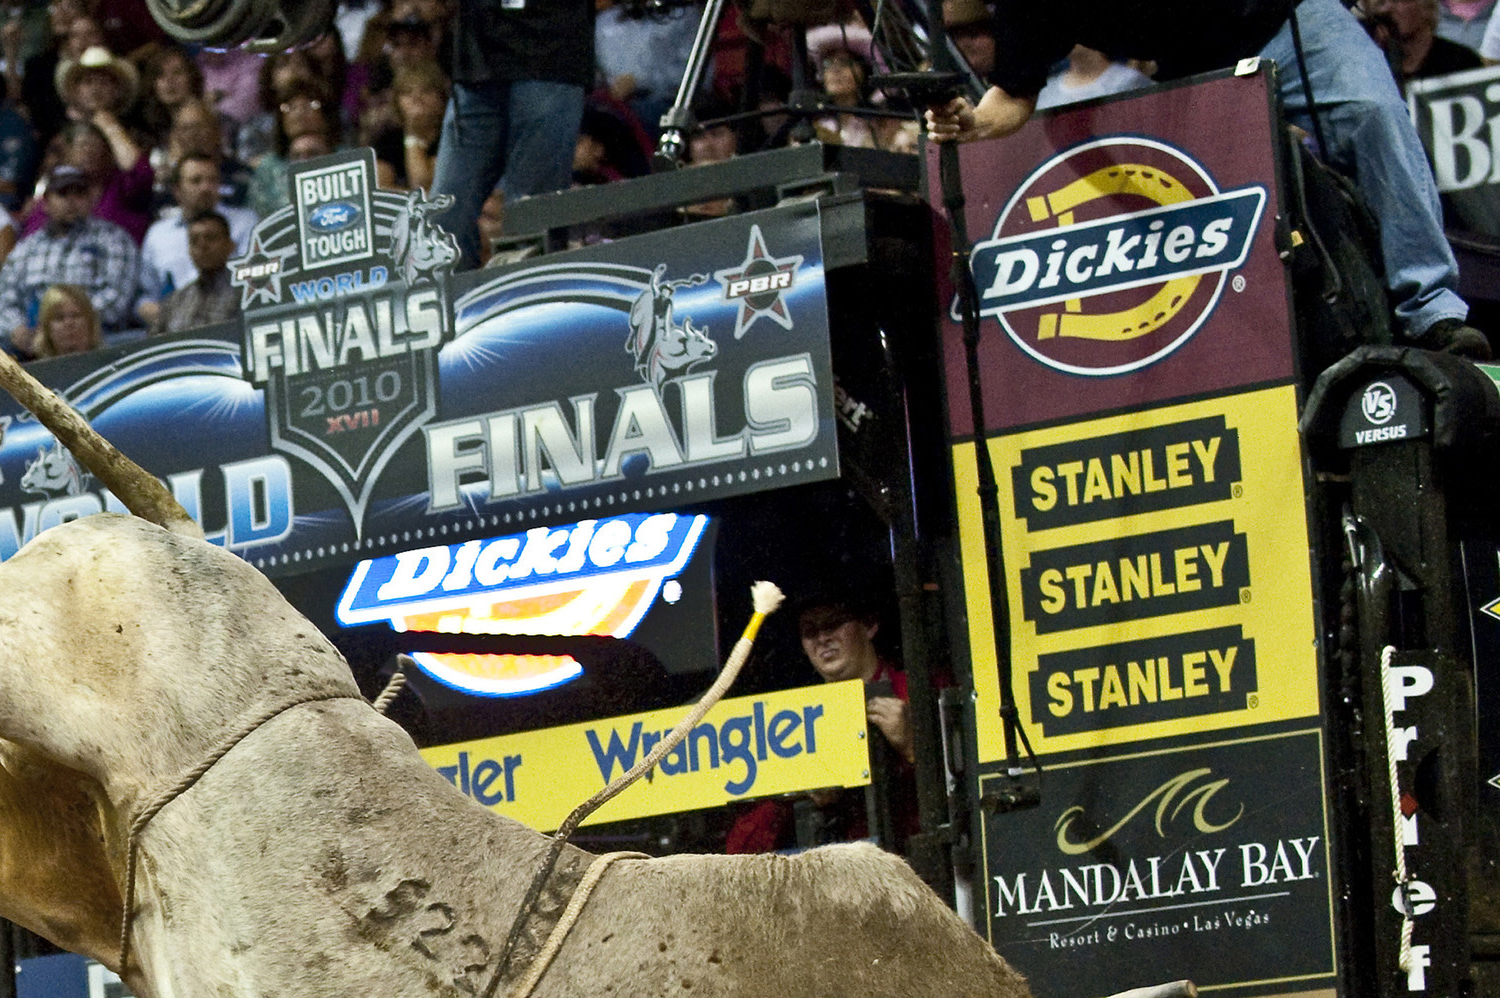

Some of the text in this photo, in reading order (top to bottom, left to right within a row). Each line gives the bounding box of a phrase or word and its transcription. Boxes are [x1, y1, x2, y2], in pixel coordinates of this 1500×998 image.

[303, 168, 362, 205] BUILT
[307, 229, 366, 259] TOUGH
[982, 210, 1233, 299] Dickies
[237, 260, 280, 281] PBR
[289, 266, 389, 304] WORLD
[728, 266, 793, 297] PBR
[251, 290, 442, 382] FINALS
[301, 370, 402, 418] 2010
[327, 408, 380, 434] XVII
[427, 353, 819, 514] FINALS
[1356, 425, 1407, 444] VERSUS
[1031, 437, 1222, 512] STANLEY
[377, 512, 678, 602] Dickies
[1038, 542, 1231, 615] STANLEY
[1046, 646, 1239, 718] STANLEY
[994, 836, 1321, 918] MANDALAY BAY
[1050, 910, 1271, 950] Resort & Casino Las Vegas
